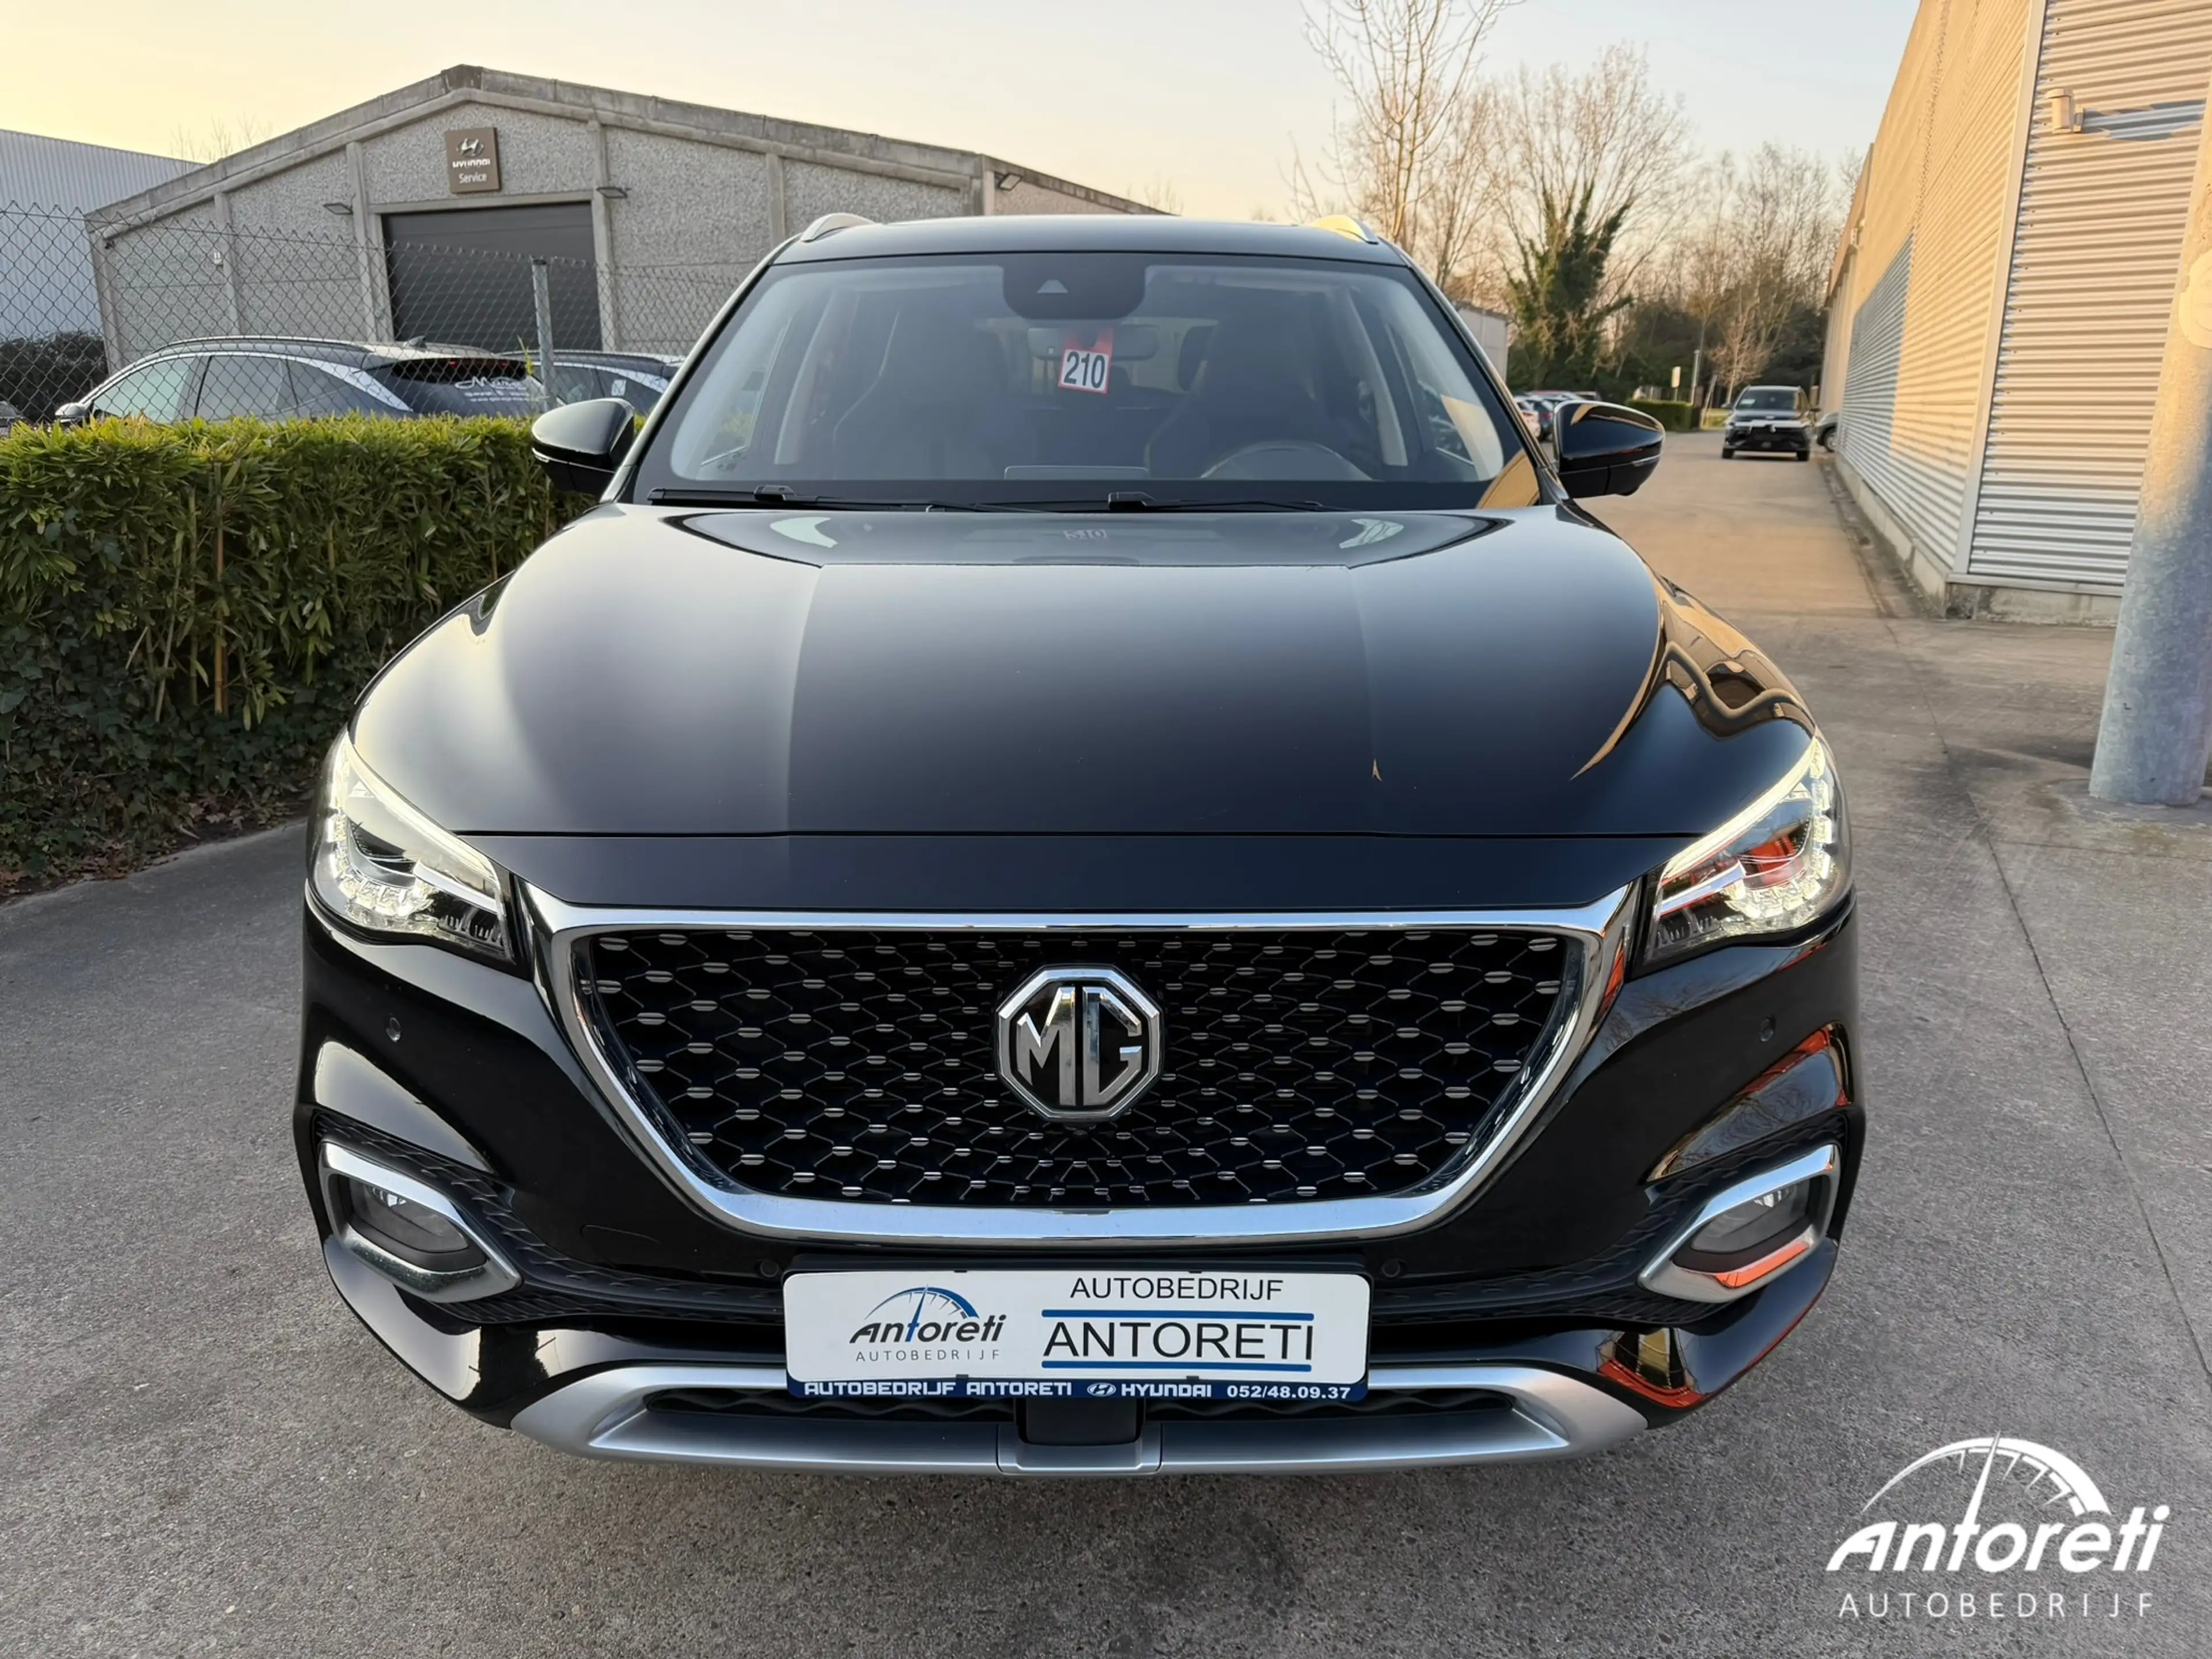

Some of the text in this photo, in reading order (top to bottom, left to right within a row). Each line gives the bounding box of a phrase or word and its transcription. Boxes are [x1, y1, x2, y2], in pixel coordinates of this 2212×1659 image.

[452, 158, 491, 168] HYUNDAI
[459, 172, 487, 184] Service
[1063, 351, 1105, 389] 210
[1016, 986, 1142, 1106] MG
[1070, 1277, 1283, 1301] AUTOBEDRIJF
[849, 1315, 1007, 1343] Antoreti
[1043, 1321, 1313, 1361] ANTORETI
[855, 1349, 1000, 1362] AUTOBEDRIJF
[804, 1381, 1351, 1400] AUTOBEDRIJF ANTORETI HYUNDAI 052/48.09.37
